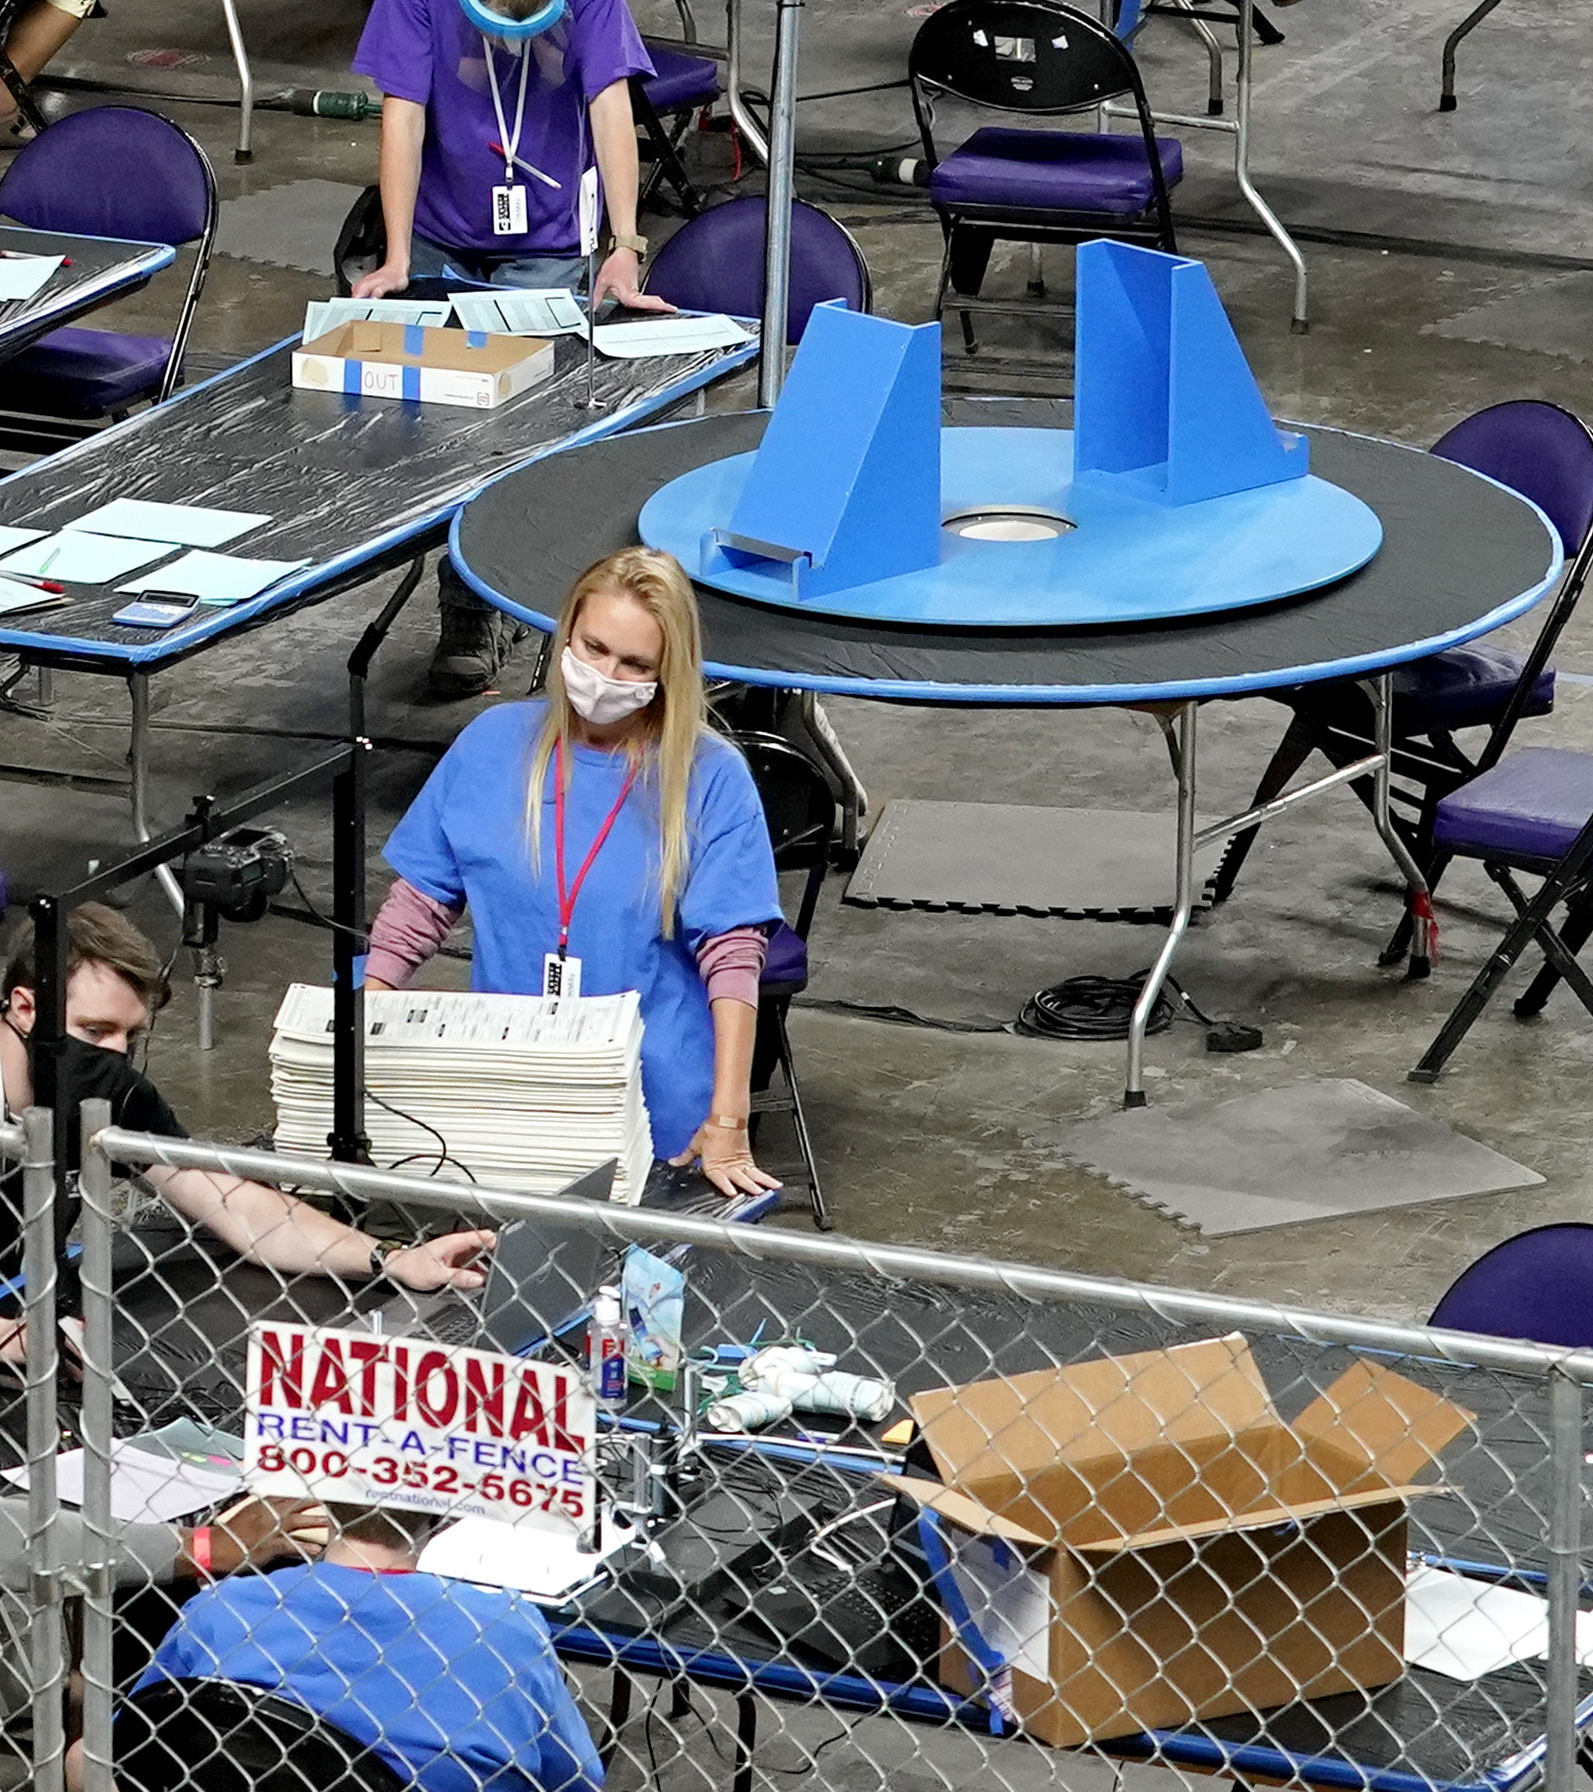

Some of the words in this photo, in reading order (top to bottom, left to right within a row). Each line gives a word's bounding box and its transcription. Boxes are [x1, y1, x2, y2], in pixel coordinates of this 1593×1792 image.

[365, 371, 399, 391] OUT
[260, 1331, 585, 1454] NATIONAL
[257, 1413, 585, 1486] RENT-A-FENCE
[258, 1445, 585, 1518] 800-352-5675
